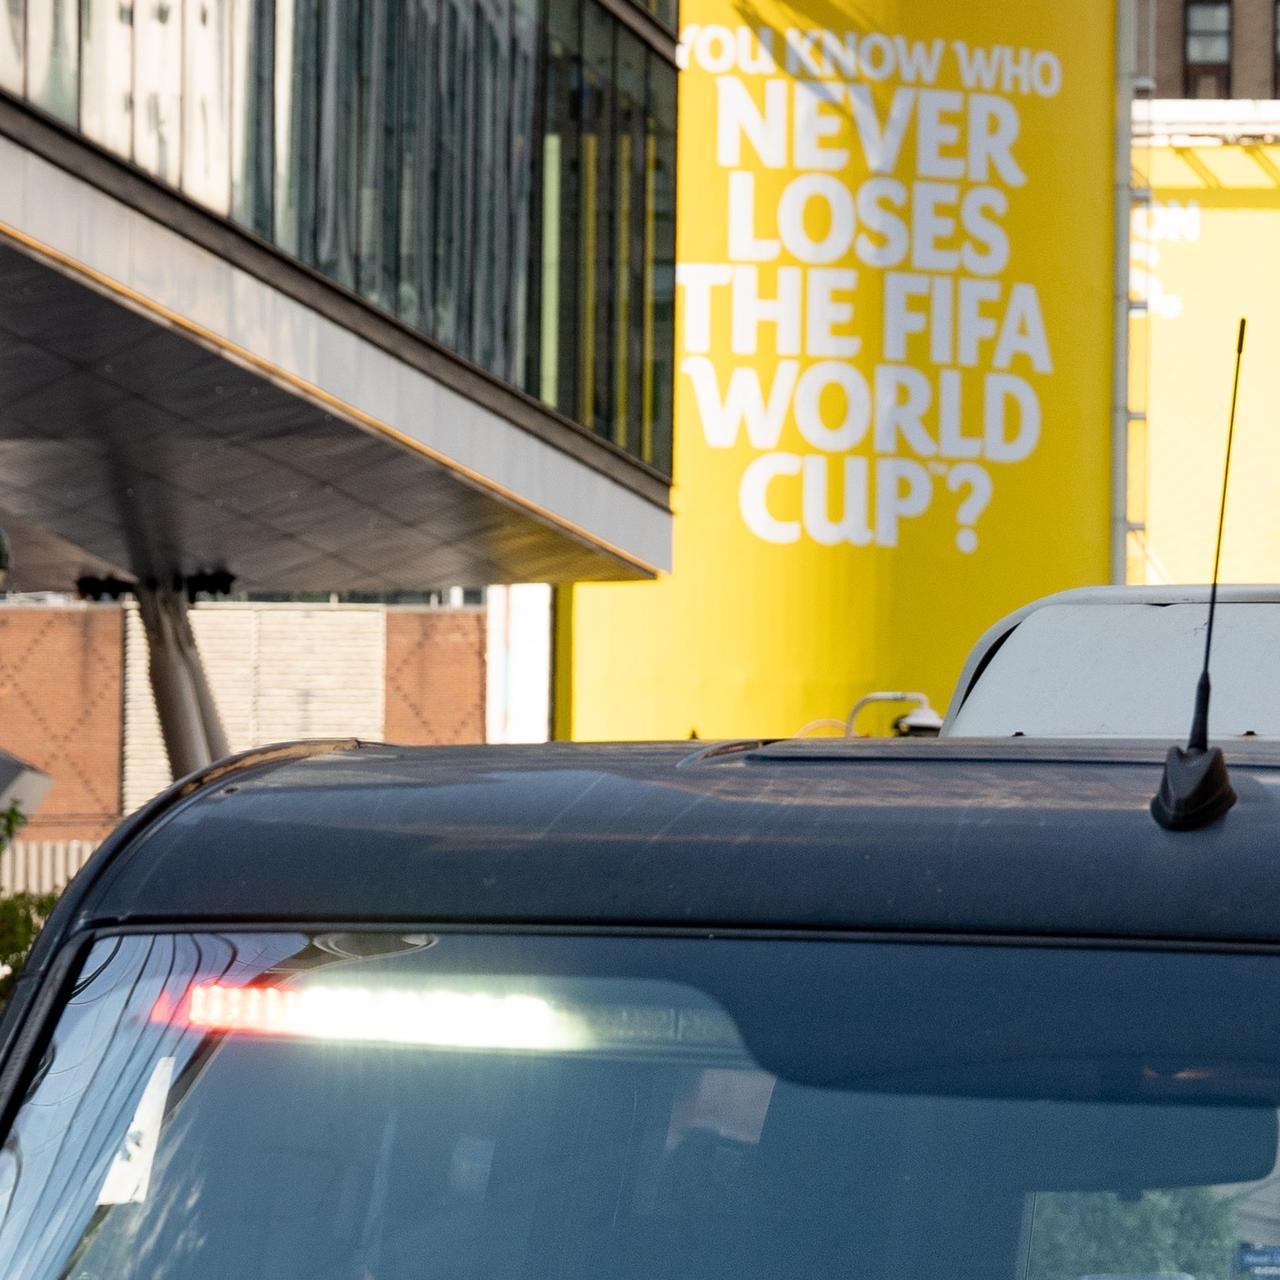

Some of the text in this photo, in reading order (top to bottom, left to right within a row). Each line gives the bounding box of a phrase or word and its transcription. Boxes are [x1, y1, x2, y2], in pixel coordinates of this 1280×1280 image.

[676, 24, 1062, 97] YOU KNOW WHO
[715, 76, 1028, 187] NEVER
[727, 171, 1010, 277] LOSES
[676, 263, 861, 358] THE
[883, 271, 1054, 375] FIFA
[681, 357, 1041, 463] WORLD
